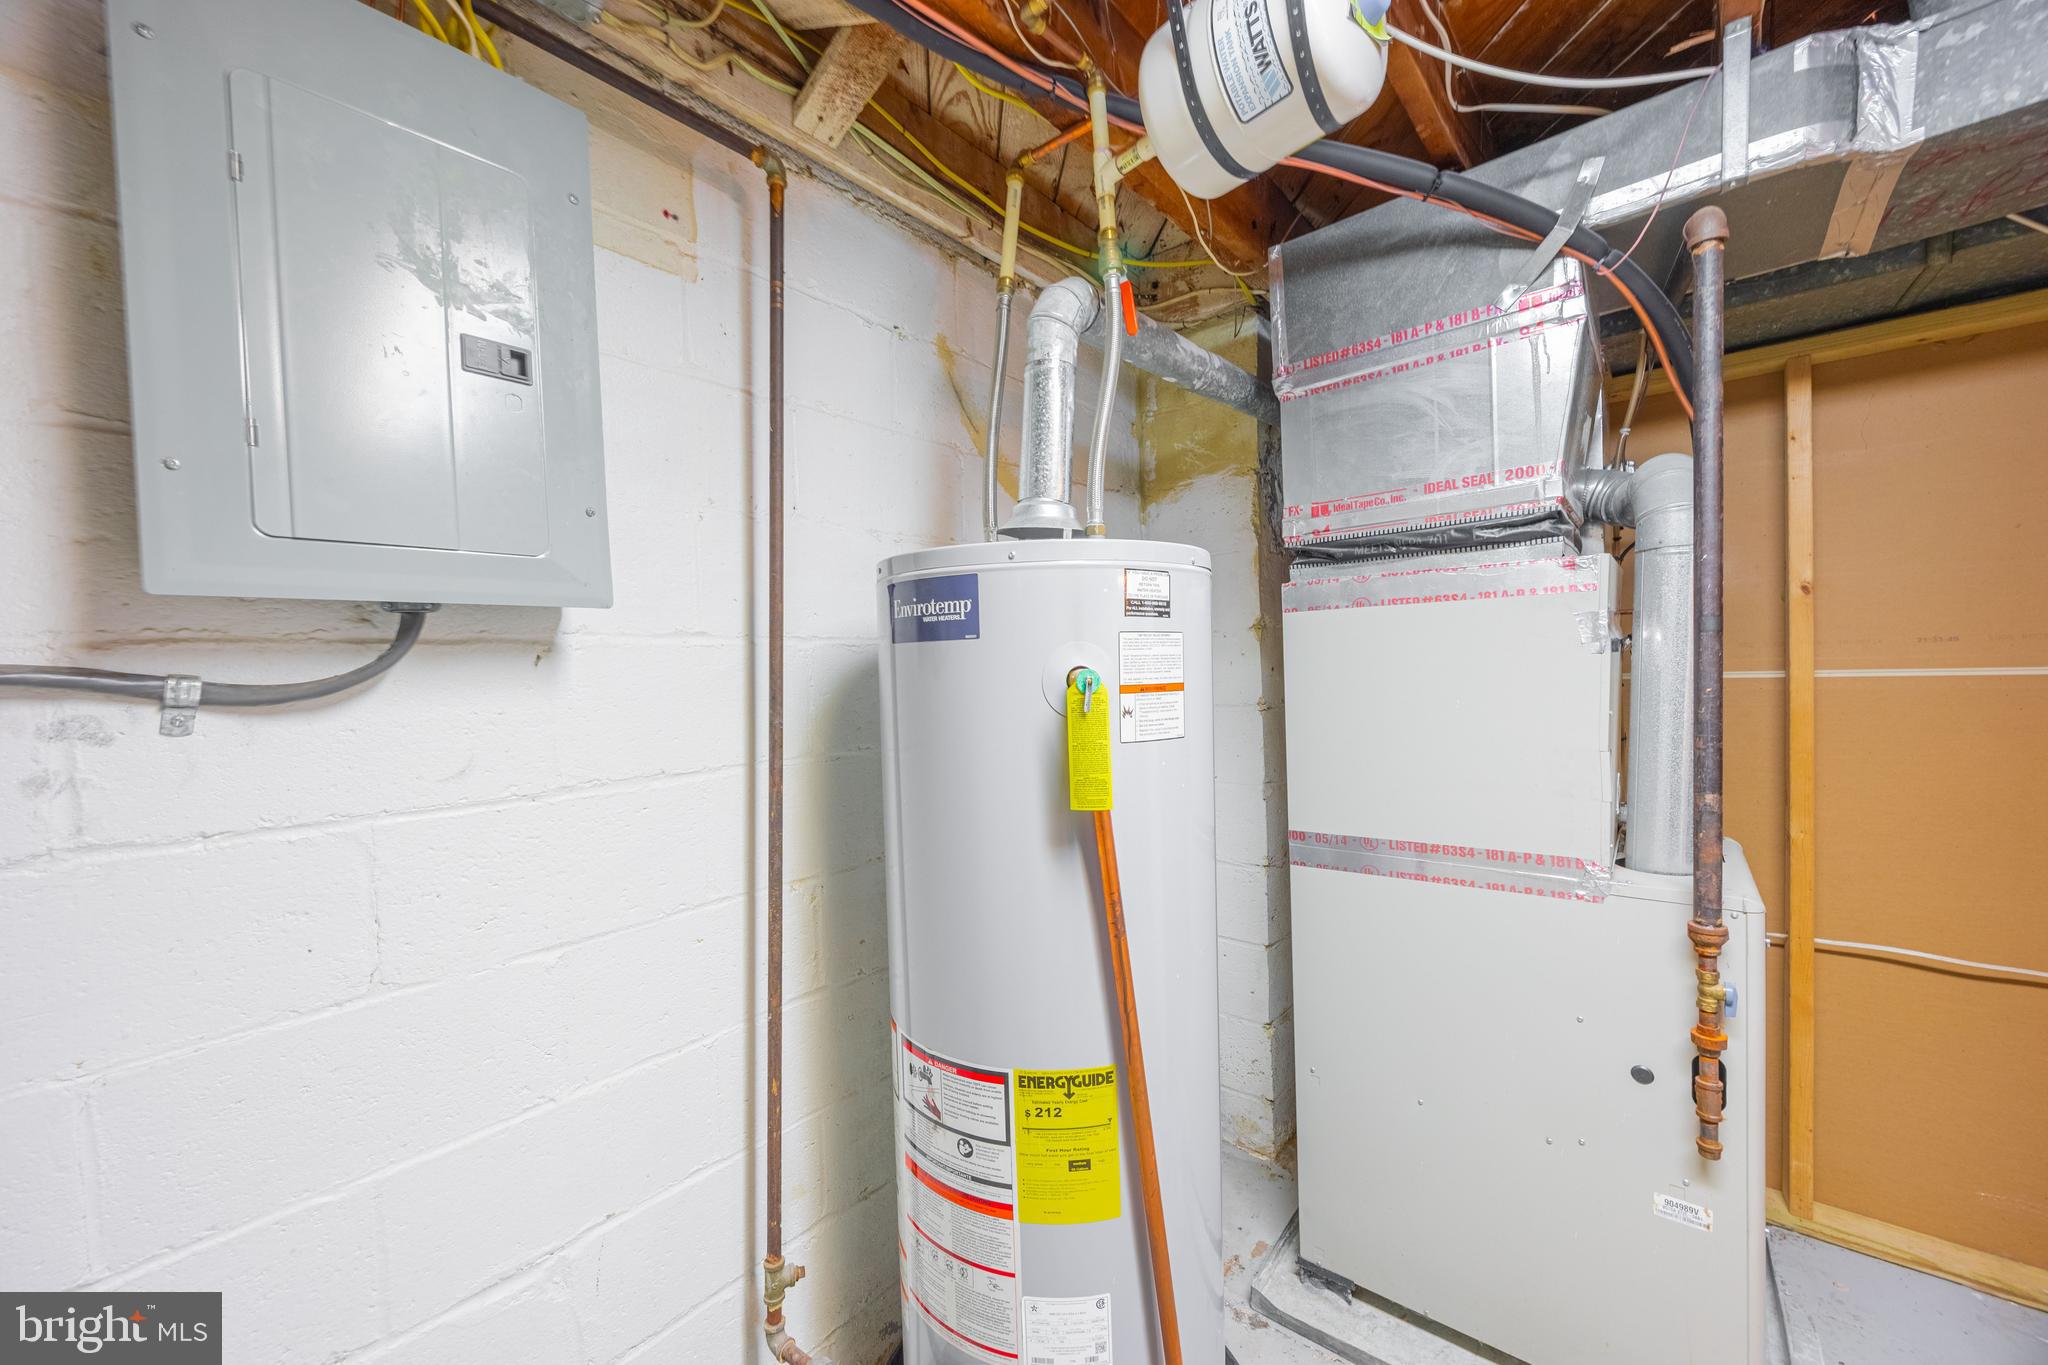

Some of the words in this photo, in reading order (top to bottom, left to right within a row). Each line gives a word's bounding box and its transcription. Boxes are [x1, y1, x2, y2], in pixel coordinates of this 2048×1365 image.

[1244, 1, 1272, 75] WATTS
[1303, 351, 1339, 370] LISTED
[1449, 310, 1468, 328] 181
[1333, 500, 1353, 513] Ideal
[1354, 498, 1373, 512] Tape
[1423, 478, 1458, 496] IDEAL
[893, 597, 972, 620] Envirotemp
[1315, 833, 1348, 850] 05/14
[1389, 840, 1428, 854] LISTED
[1485, 849, 1505, 861] 181
[1508, 851, 1532, 864] A-P
[1535, 854, 1545, 866] &
[1550, 855, 1572, 869] 181
[933, 1061, 958, 1075] DANGER
[1018, 1071, 1114, 1093] ENERGYGUIDE
[1024, 1109, 1031, 1118] $
[1035, 1107, 1063, 1118] 212
[1664, 1198, 1700, 1216] 904989V
